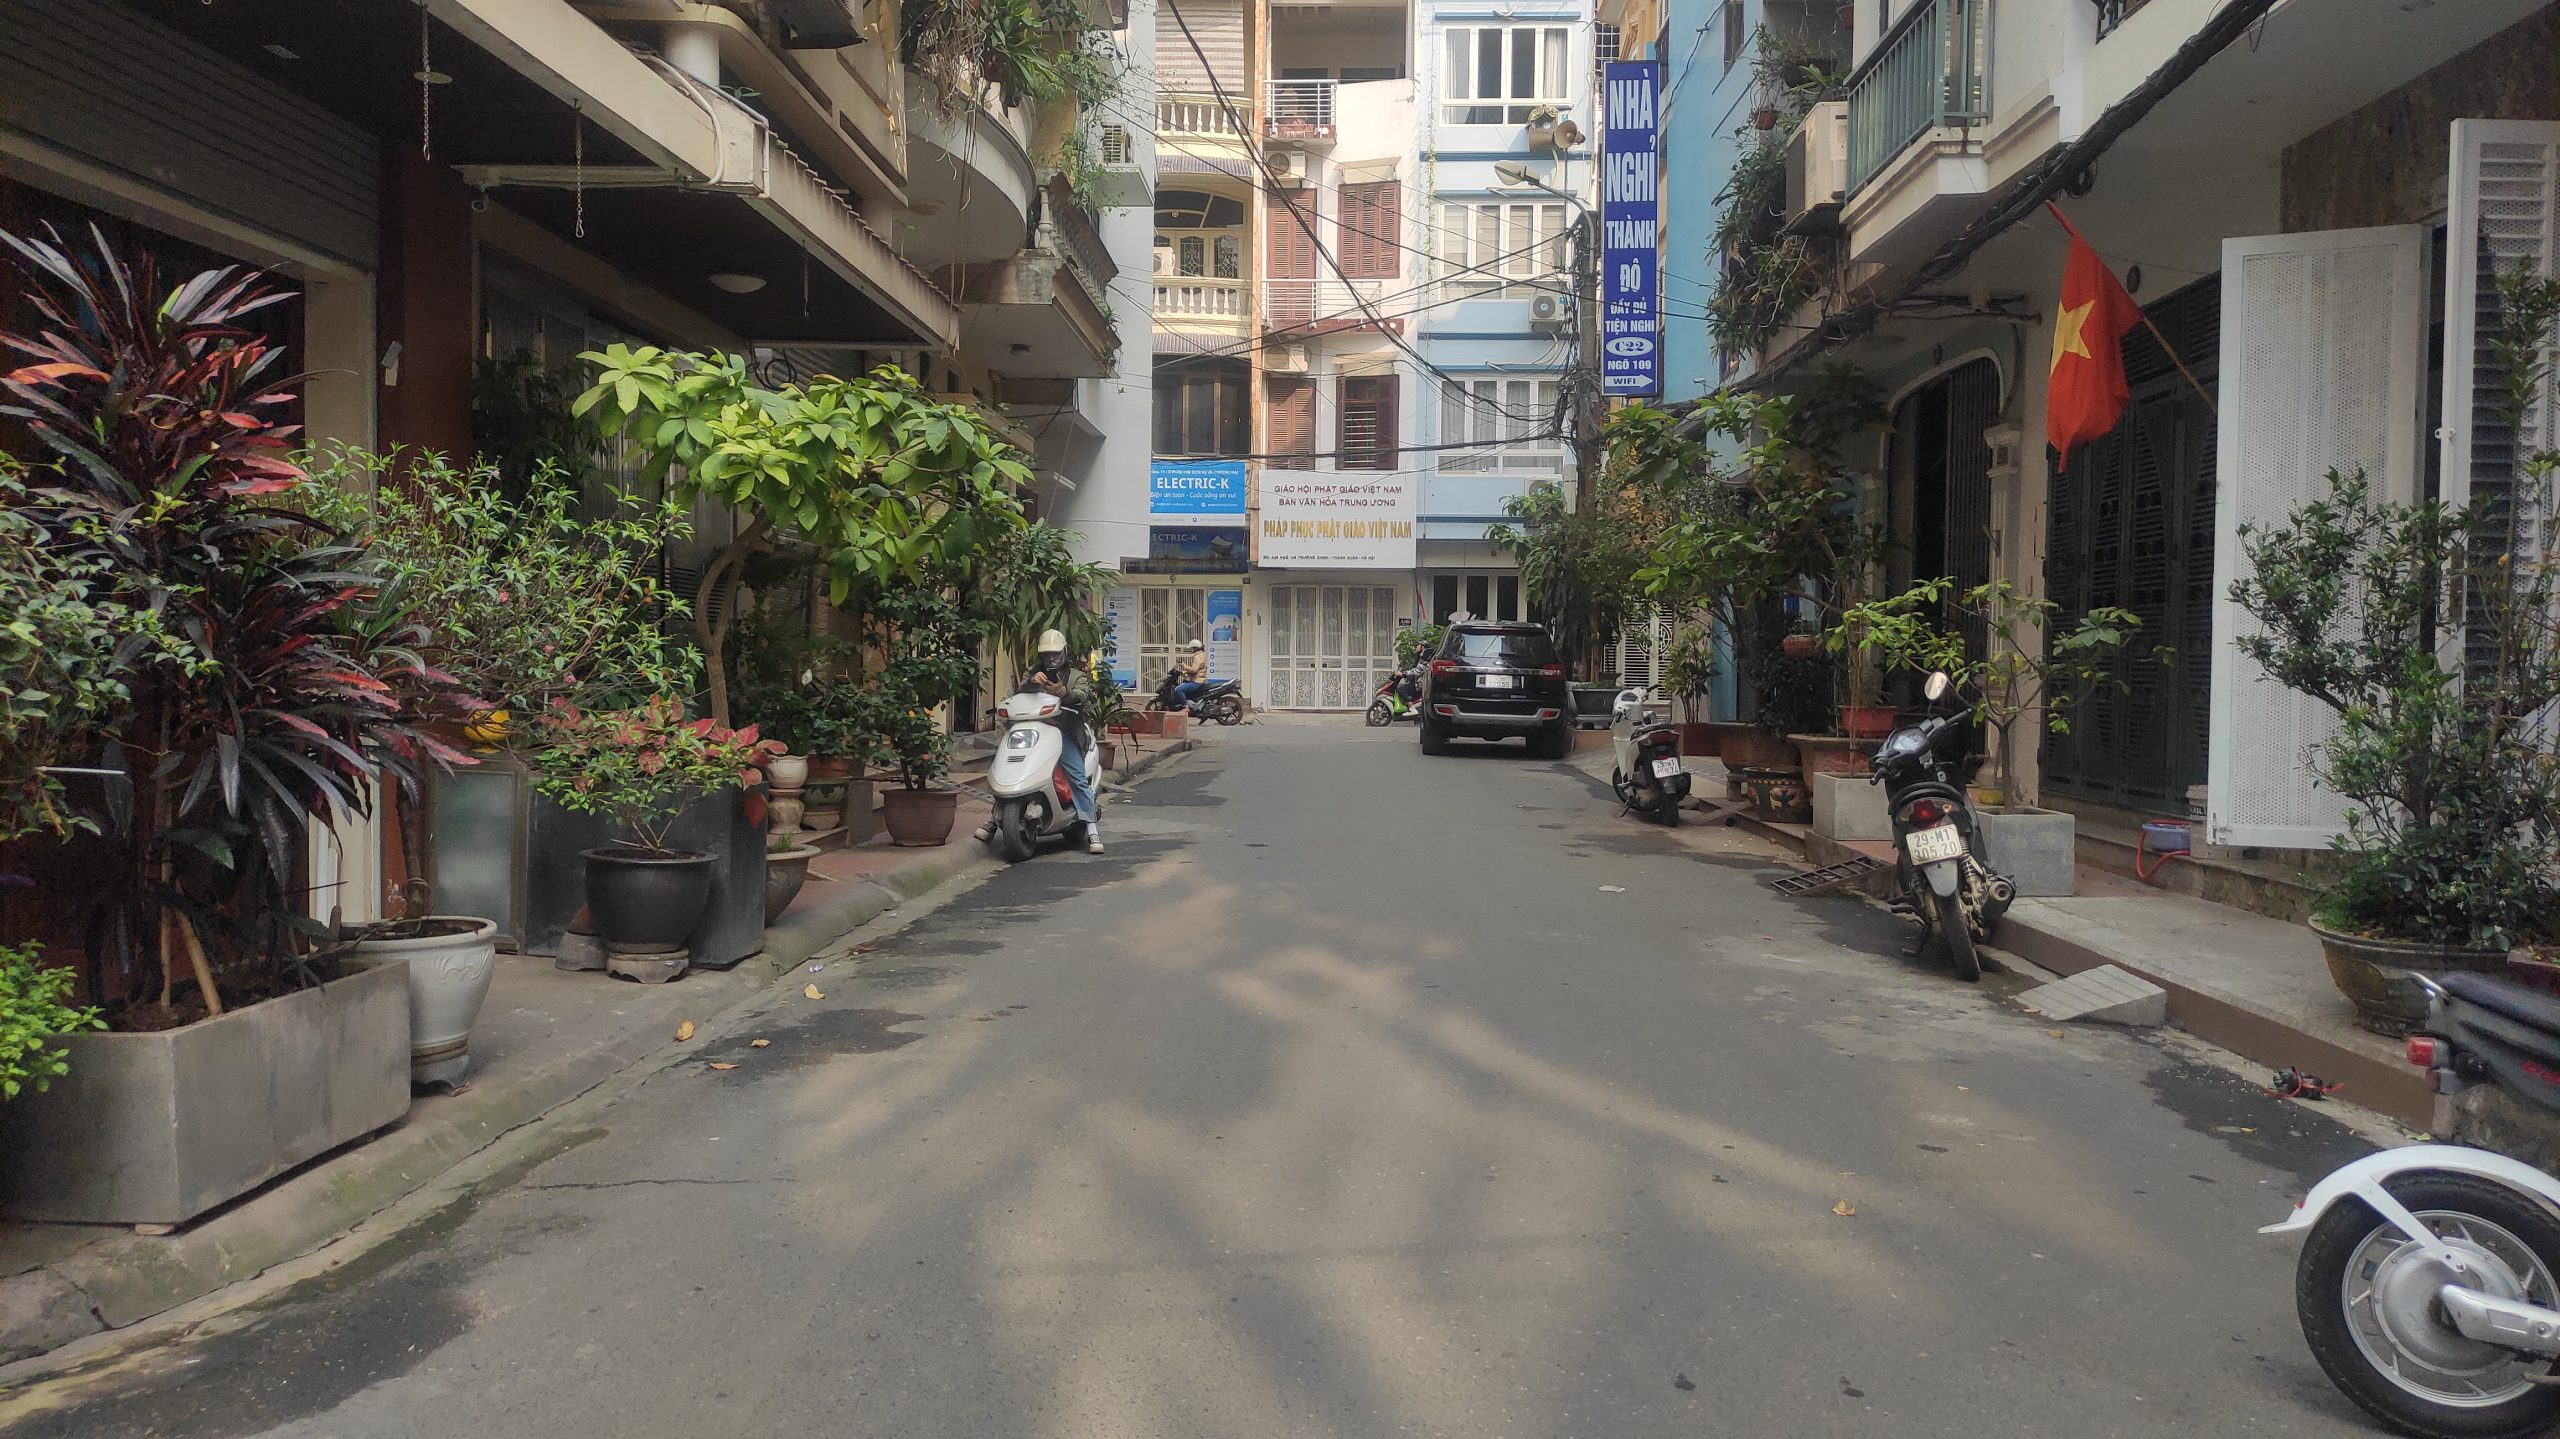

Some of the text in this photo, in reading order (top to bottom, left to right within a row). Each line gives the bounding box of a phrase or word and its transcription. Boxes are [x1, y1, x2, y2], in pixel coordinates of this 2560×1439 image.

[1609, 69, 1653, 130] NHÀ
[1606, 134, 1656, 203] NGHỈ
[1606, 214, 1655, 249] THÀNH
[1619, 257, 1641, 293] ĐÔ
[1604, 317, 1655, 335] TIỆN NGHI
[1614, 340, 1645, 352] C22
[1607, 358, 1652, 370] NGÕ 109
[1613, 377, 1636, 385] WIFI
[1156, 477, 1229, 489] ELECTRIC-K
[1274, 483, 1402, 495] GIÁO HỘI PHẬT GIÁO VIỆT NAM
[1298, 497, 1316, 506] VĂN
[1339, 499, 1368, 507] TRUNG
[1370, 499, 1396, 507] ƯƠNG
[1263, 516, 1412, 543] PHÁP PHỤC PHẬT GIÁO VIỆT NAM
[1109, 601, 1116, 609] 5
[1913, 828, 1951, 848] 29-M1
[1913, 841, 1958, 860] 305.20
